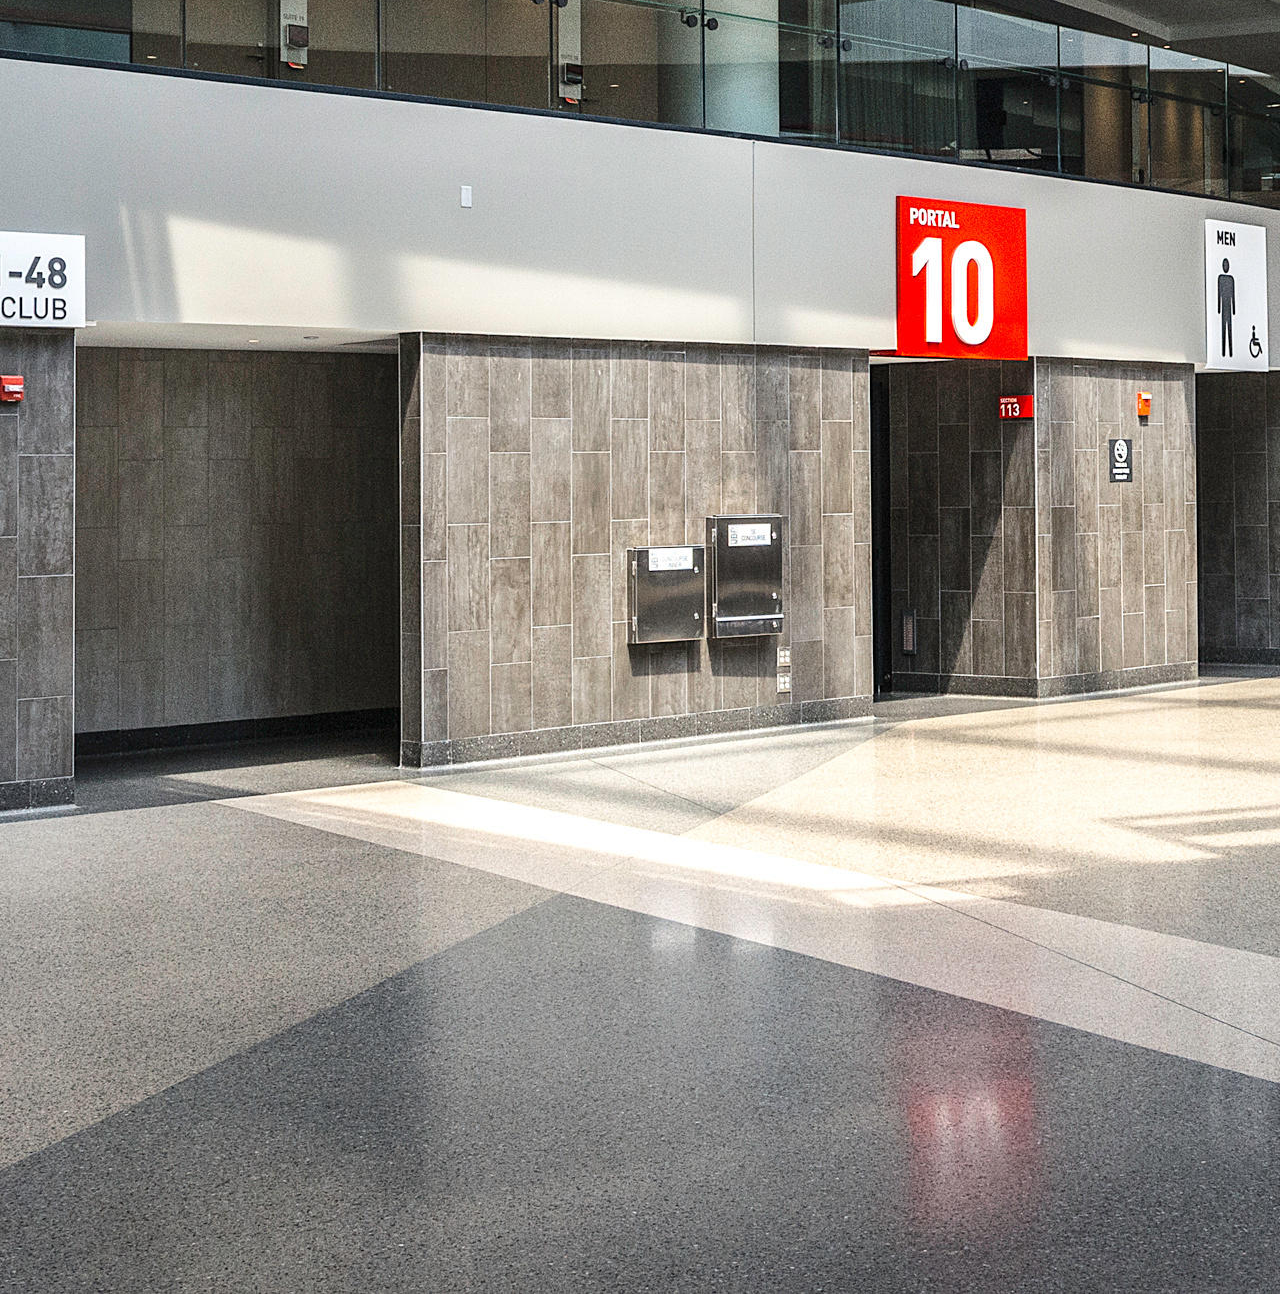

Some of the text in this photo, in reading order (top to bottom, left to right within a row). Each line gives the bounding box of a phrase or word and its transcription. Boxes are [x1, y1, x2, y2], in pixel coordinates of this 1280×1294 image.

[909, 207, 960, 230] PORTAL
[1216, 229, 1237, 247] MEN
[911, 236, 994, 346] 10
[0, 296, 67, 321] CLUB
[1000, 404, 1020, 417] 113
